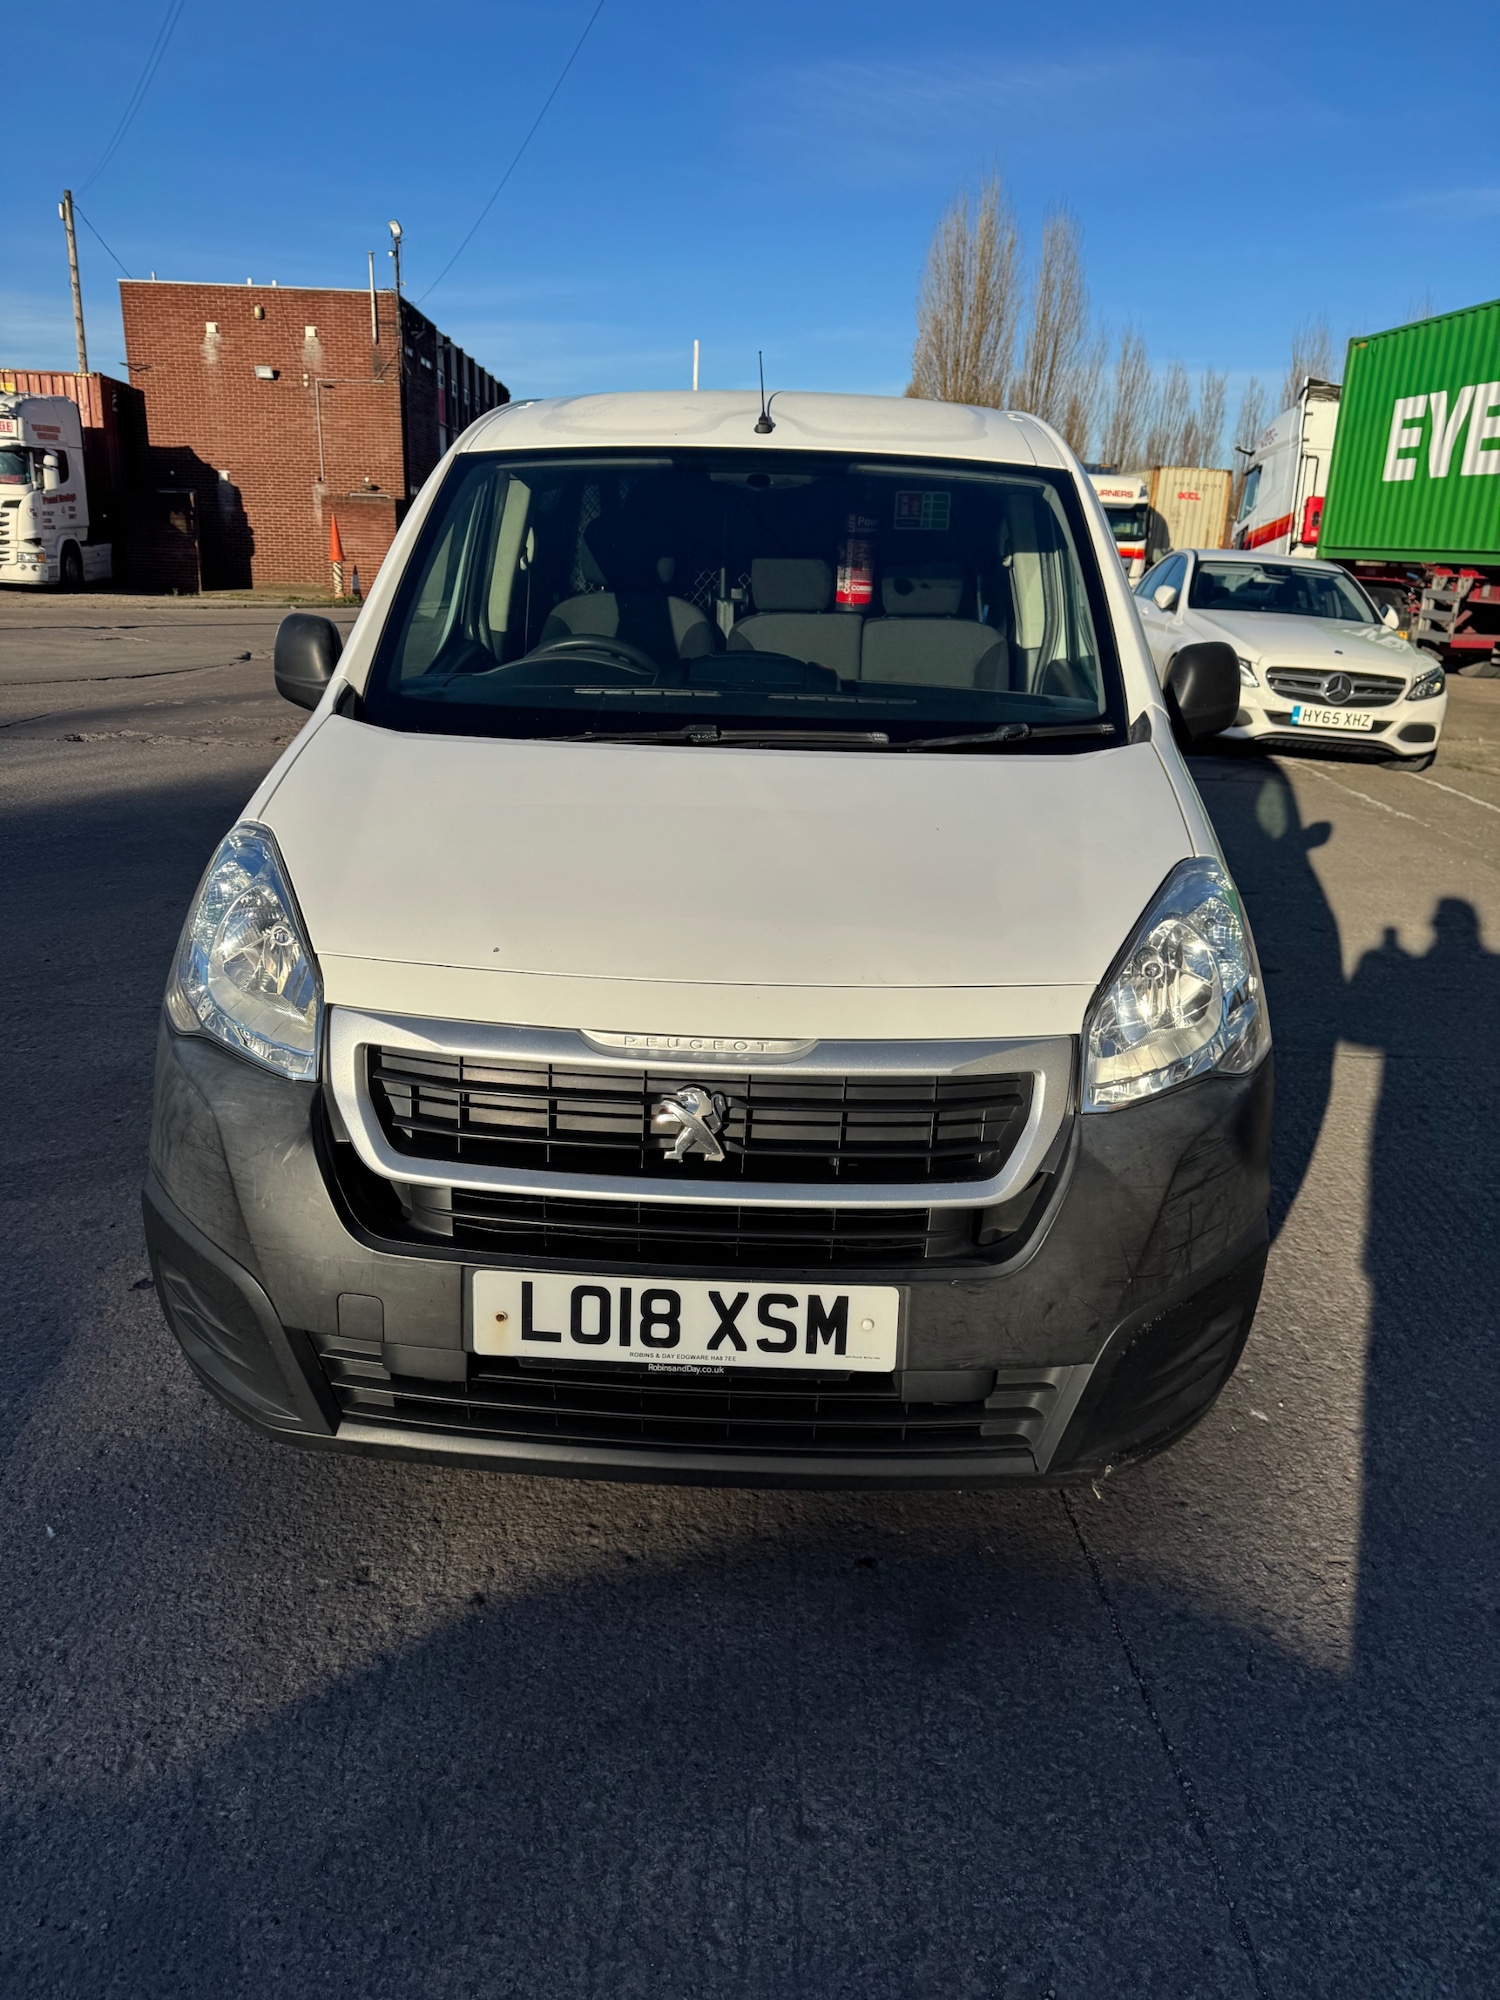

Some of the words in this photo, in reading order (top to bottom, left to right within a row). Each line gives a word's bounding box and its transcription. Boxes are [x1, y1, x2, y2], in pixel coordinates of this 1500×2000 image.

[1382, 381, 1500, 482] EVE
[1098, 489, 1134, 499] URNERS
[1303, 709, 1341, 724] HY65
[1344, 713, 1371, 727] XHZ
[624, 1036, 770, 1052] PEUGEOT
[521, 1281, 682, 1348] LO18
[707, 1291, 849, 1355] XSM
[648, 1363, 725, 1374] RobinsandDay.co.uk
